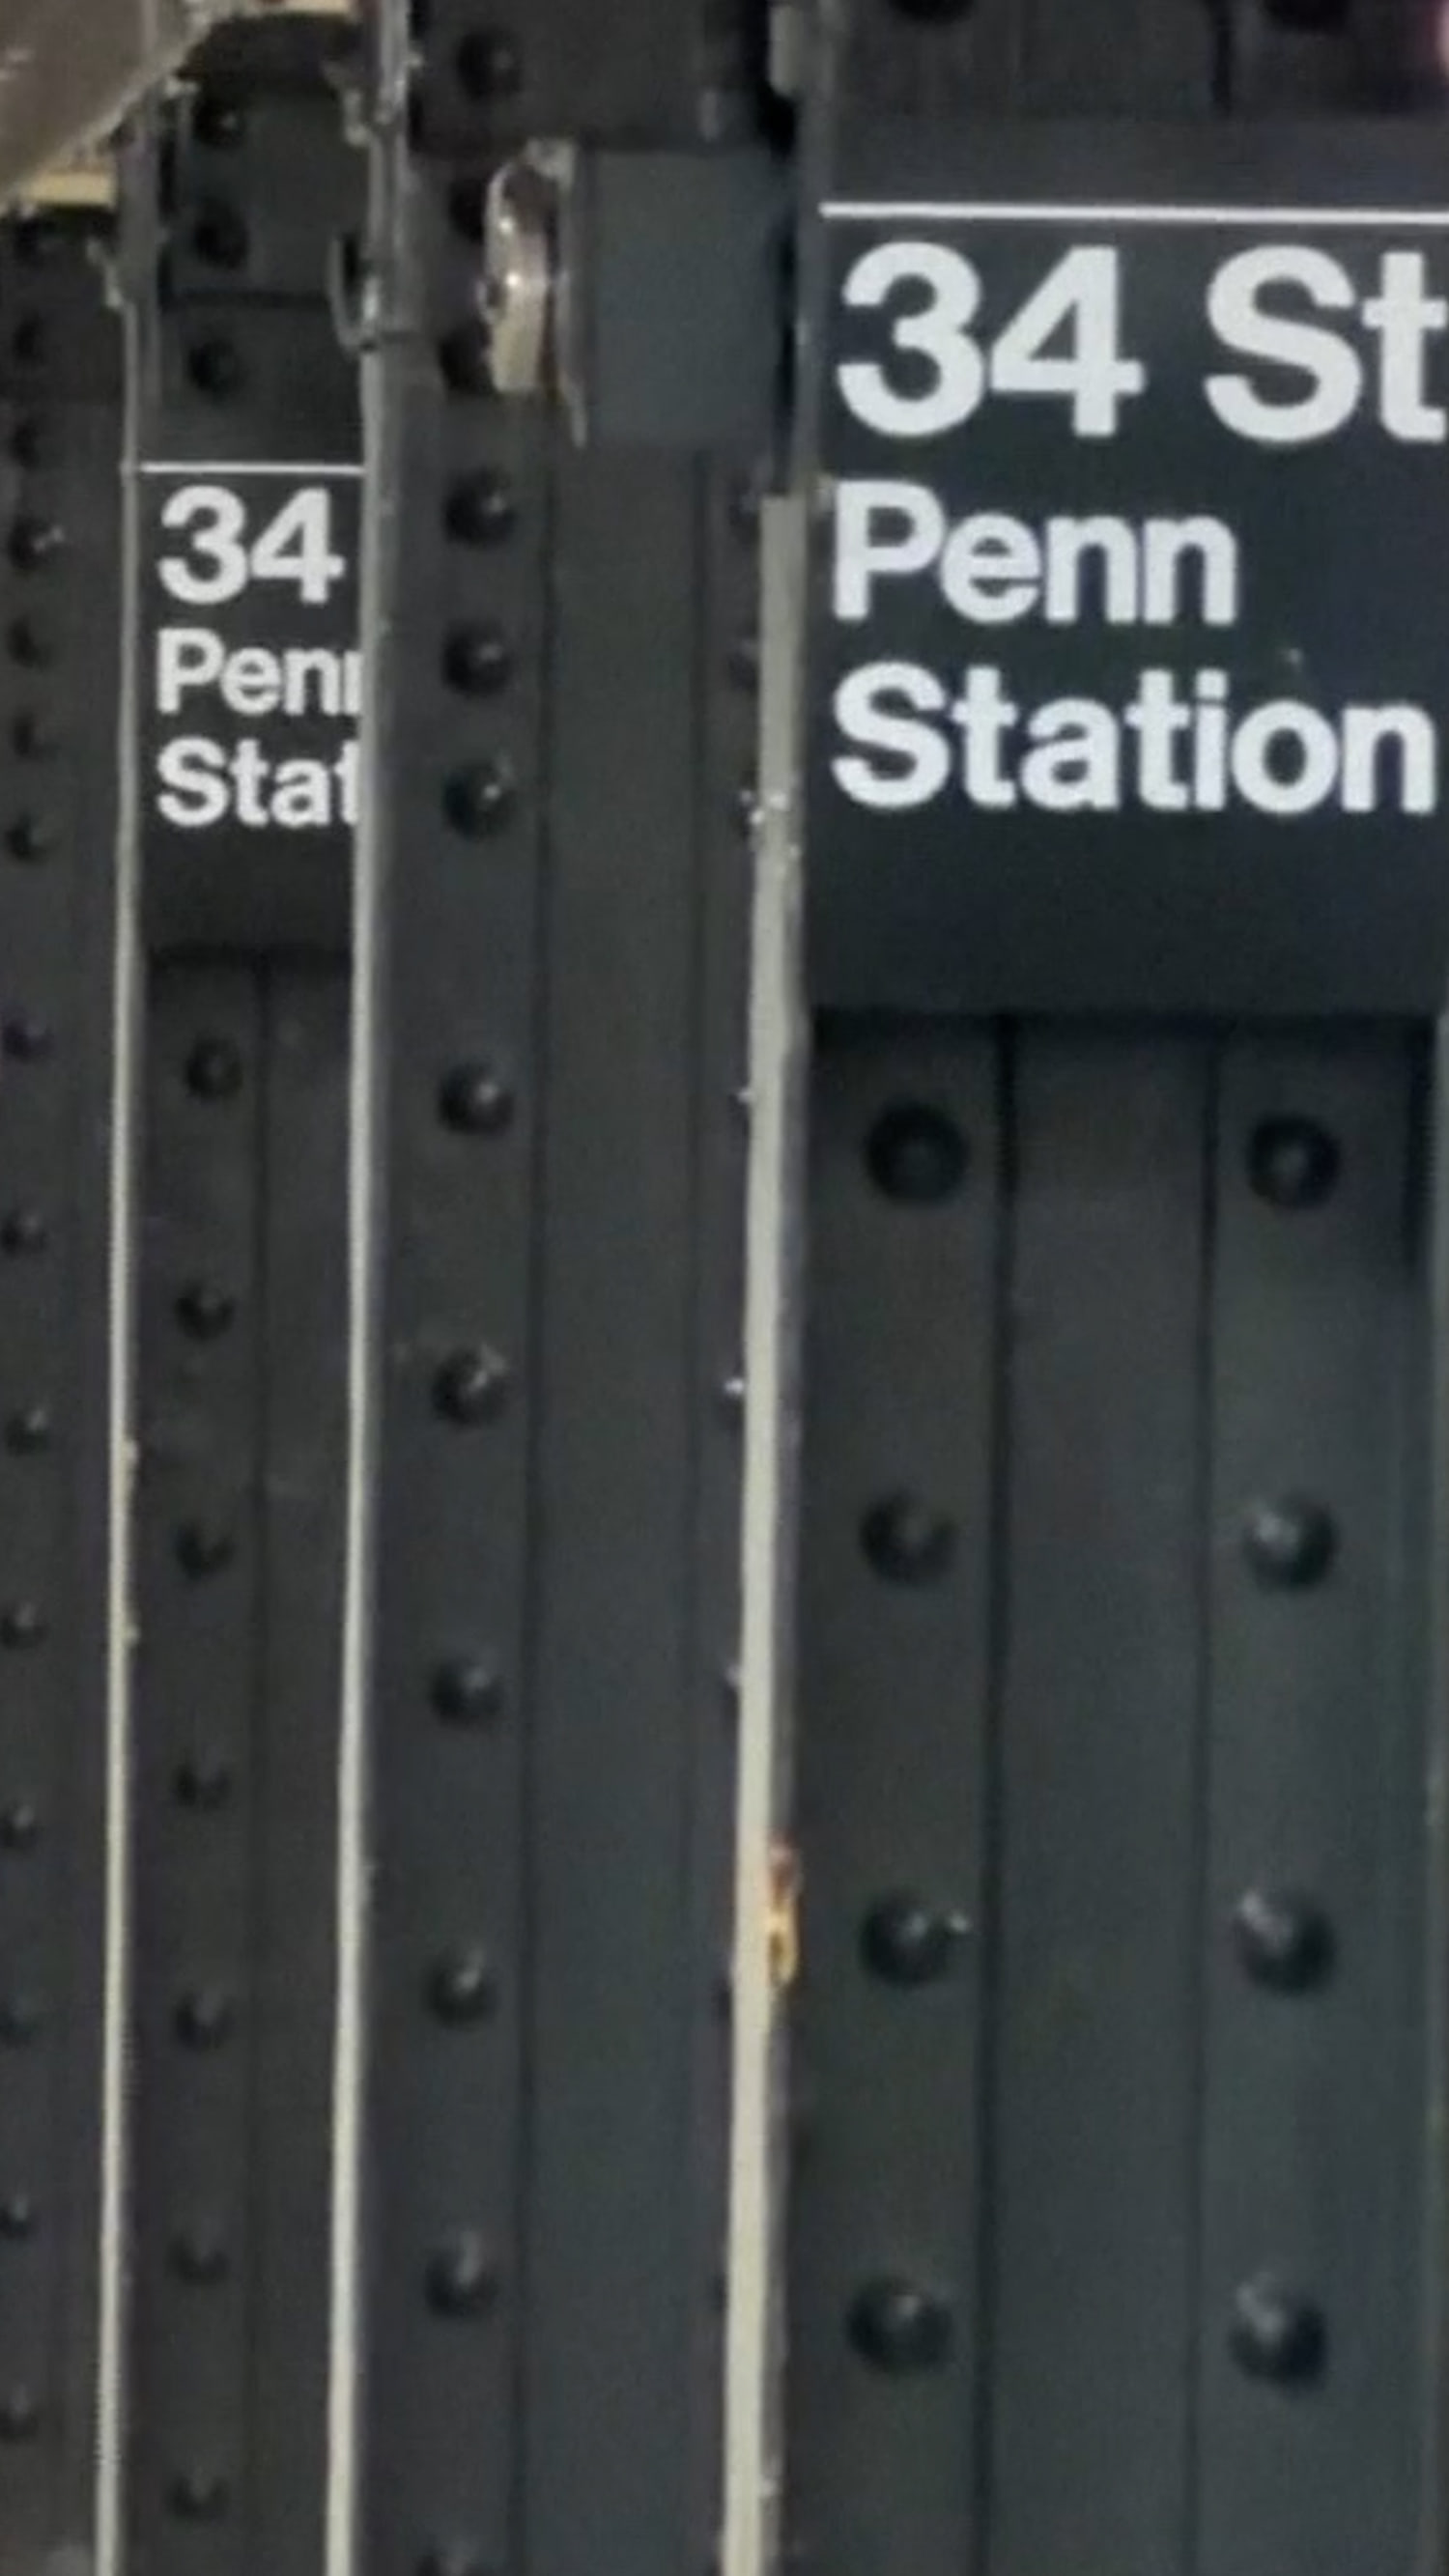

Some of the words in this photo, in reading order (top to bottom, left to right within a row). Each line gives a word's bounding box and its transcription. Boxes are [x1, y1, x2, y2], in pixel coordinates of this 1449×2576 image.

[838, 241, 1145, 437] 34
[1204, 244, 1448, 443] St
[157, 485, 345, 604] 34
[833, 480, 1237, 625] Penn
[156, 627, 361, 716] Pen
[832, 662, 1436, 813] Station
